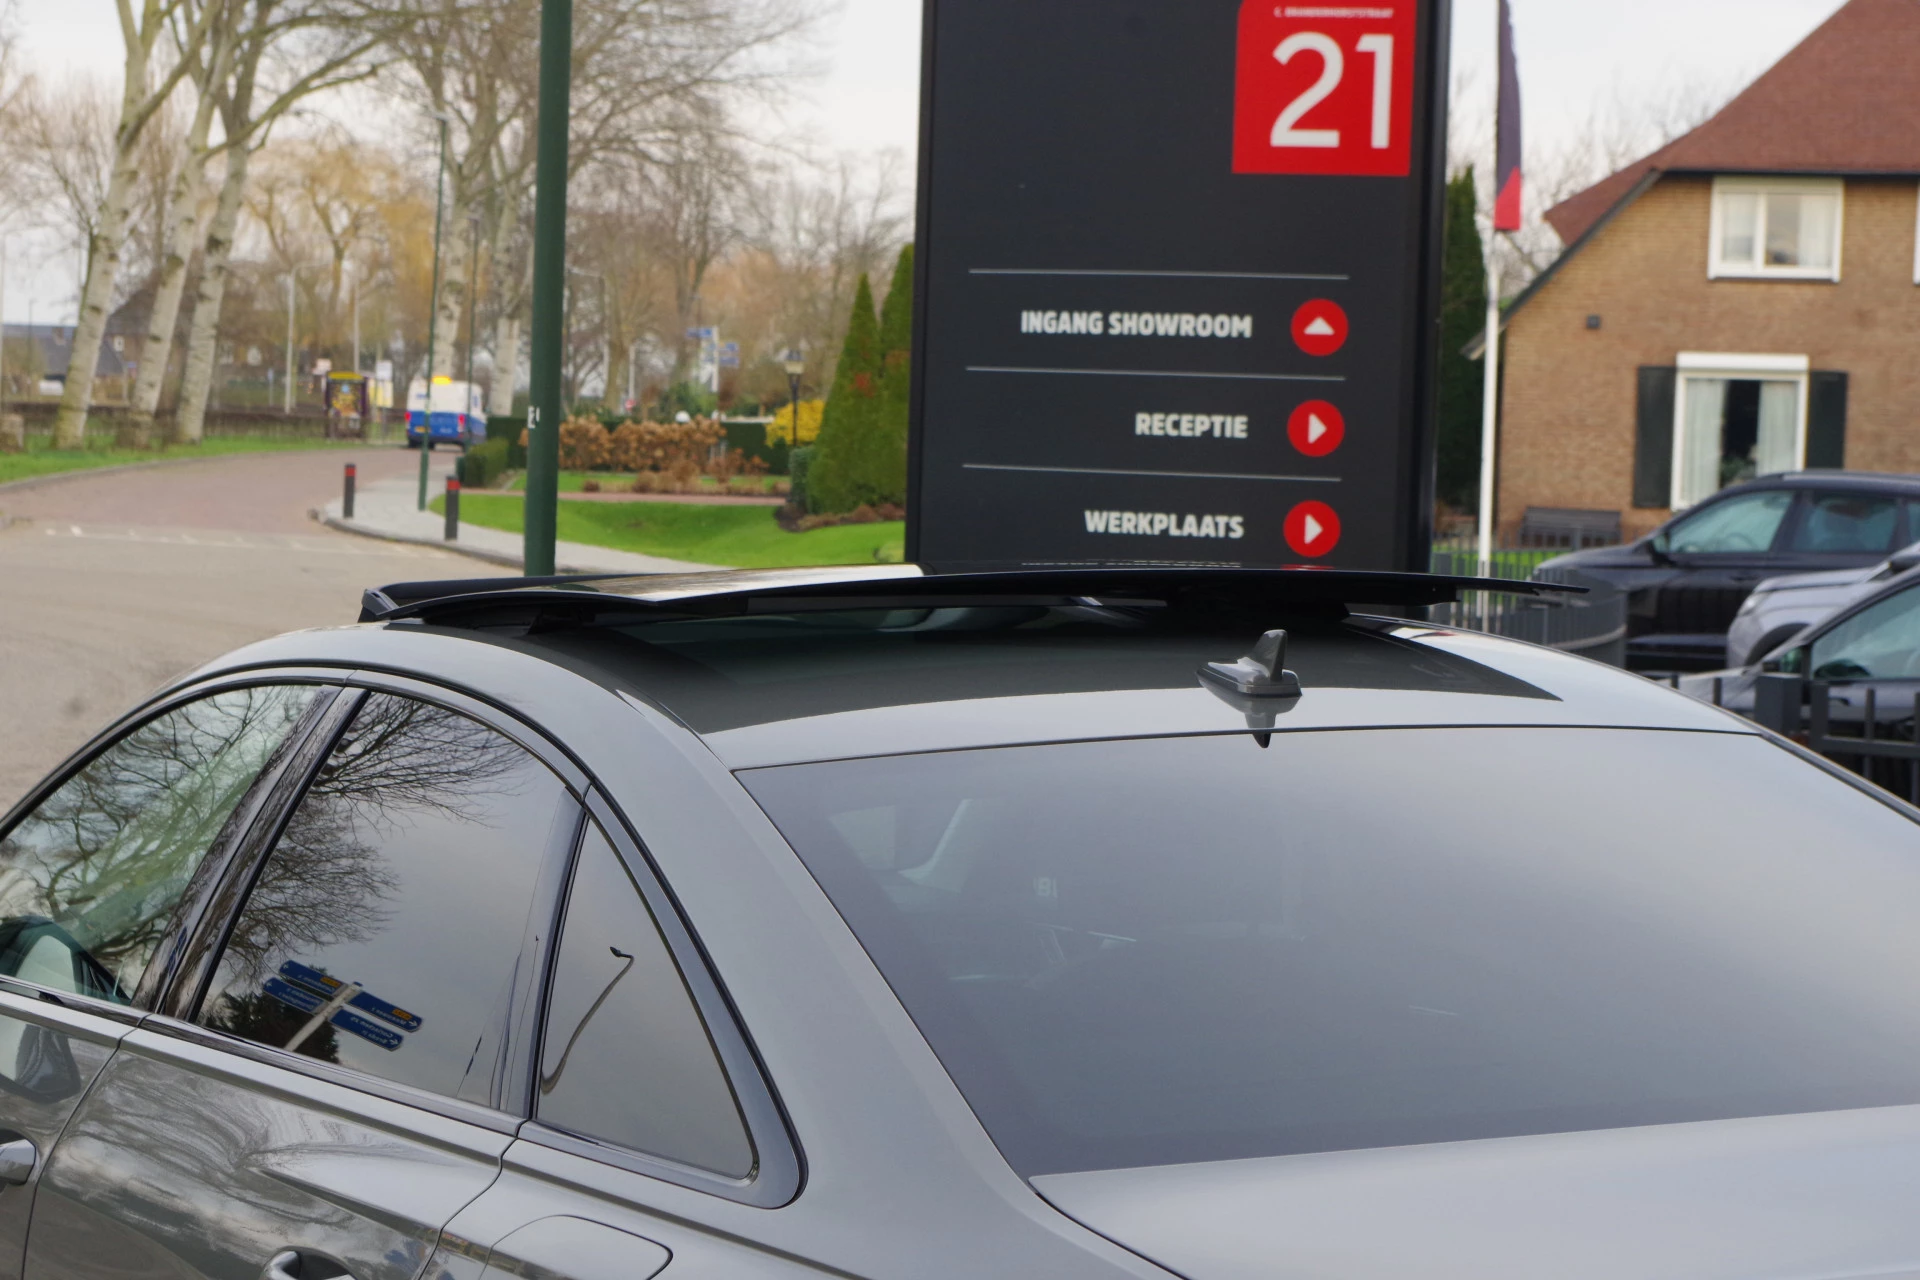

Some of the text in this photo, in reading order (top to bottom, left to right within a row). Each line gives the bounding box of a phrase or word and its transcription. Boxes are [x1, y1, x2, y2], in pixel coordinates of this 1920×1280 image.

[1270, 31, 1394, 149] 21
[1021, 310, 1252, 338] INGANG SHOWROOM
[1135, 412, 1249, 439] RECEPTIE
[1084, 509, 1245, 539] WERKPLAATS
